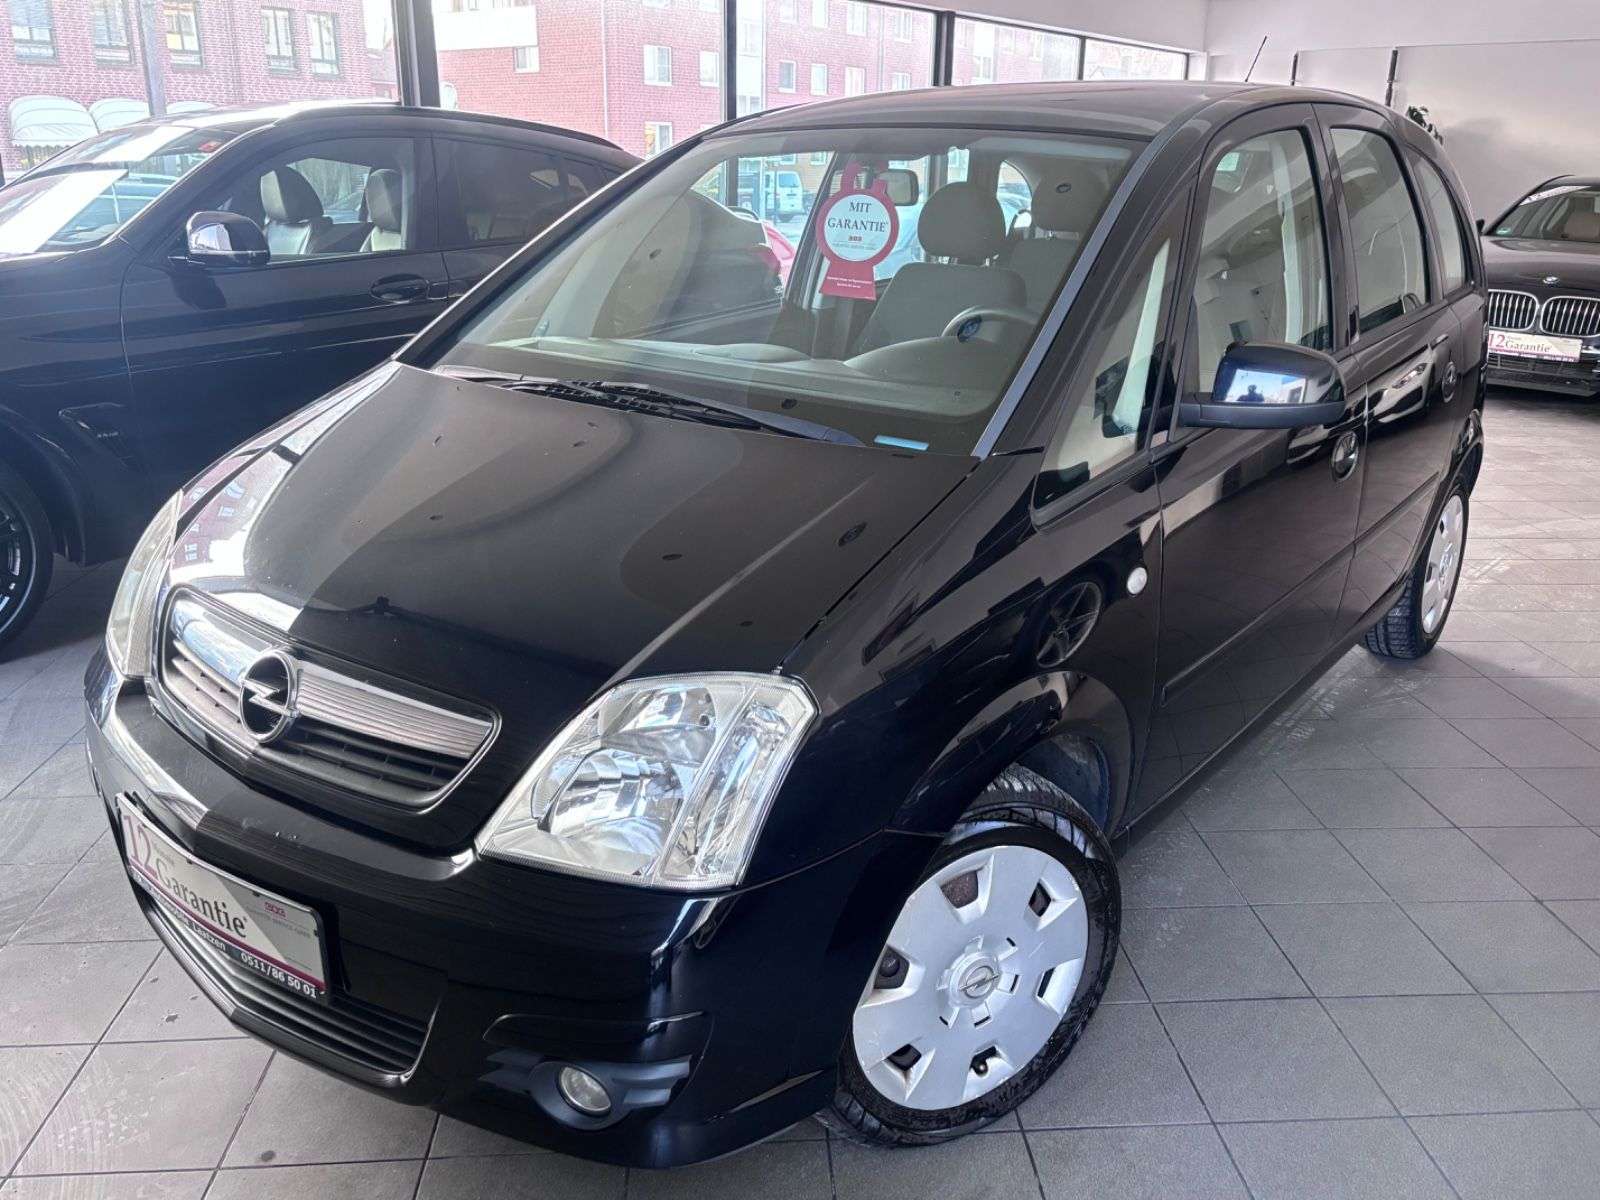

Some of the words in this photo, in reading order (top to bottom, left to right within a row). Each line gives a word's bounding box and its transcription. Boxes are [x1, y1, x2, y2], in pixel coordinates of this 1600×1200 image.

[849, 201, 871, 213] MIT
[827, 218, 886, 232] GARANTIE
[1488, 333, 1506, 348] 12
[1505, 340, 1551, 353] Garantie
[155, 858, 246, 938] Garantie
[287, 975, 301, 990] 50
[303, 984, 317, 999] 01
